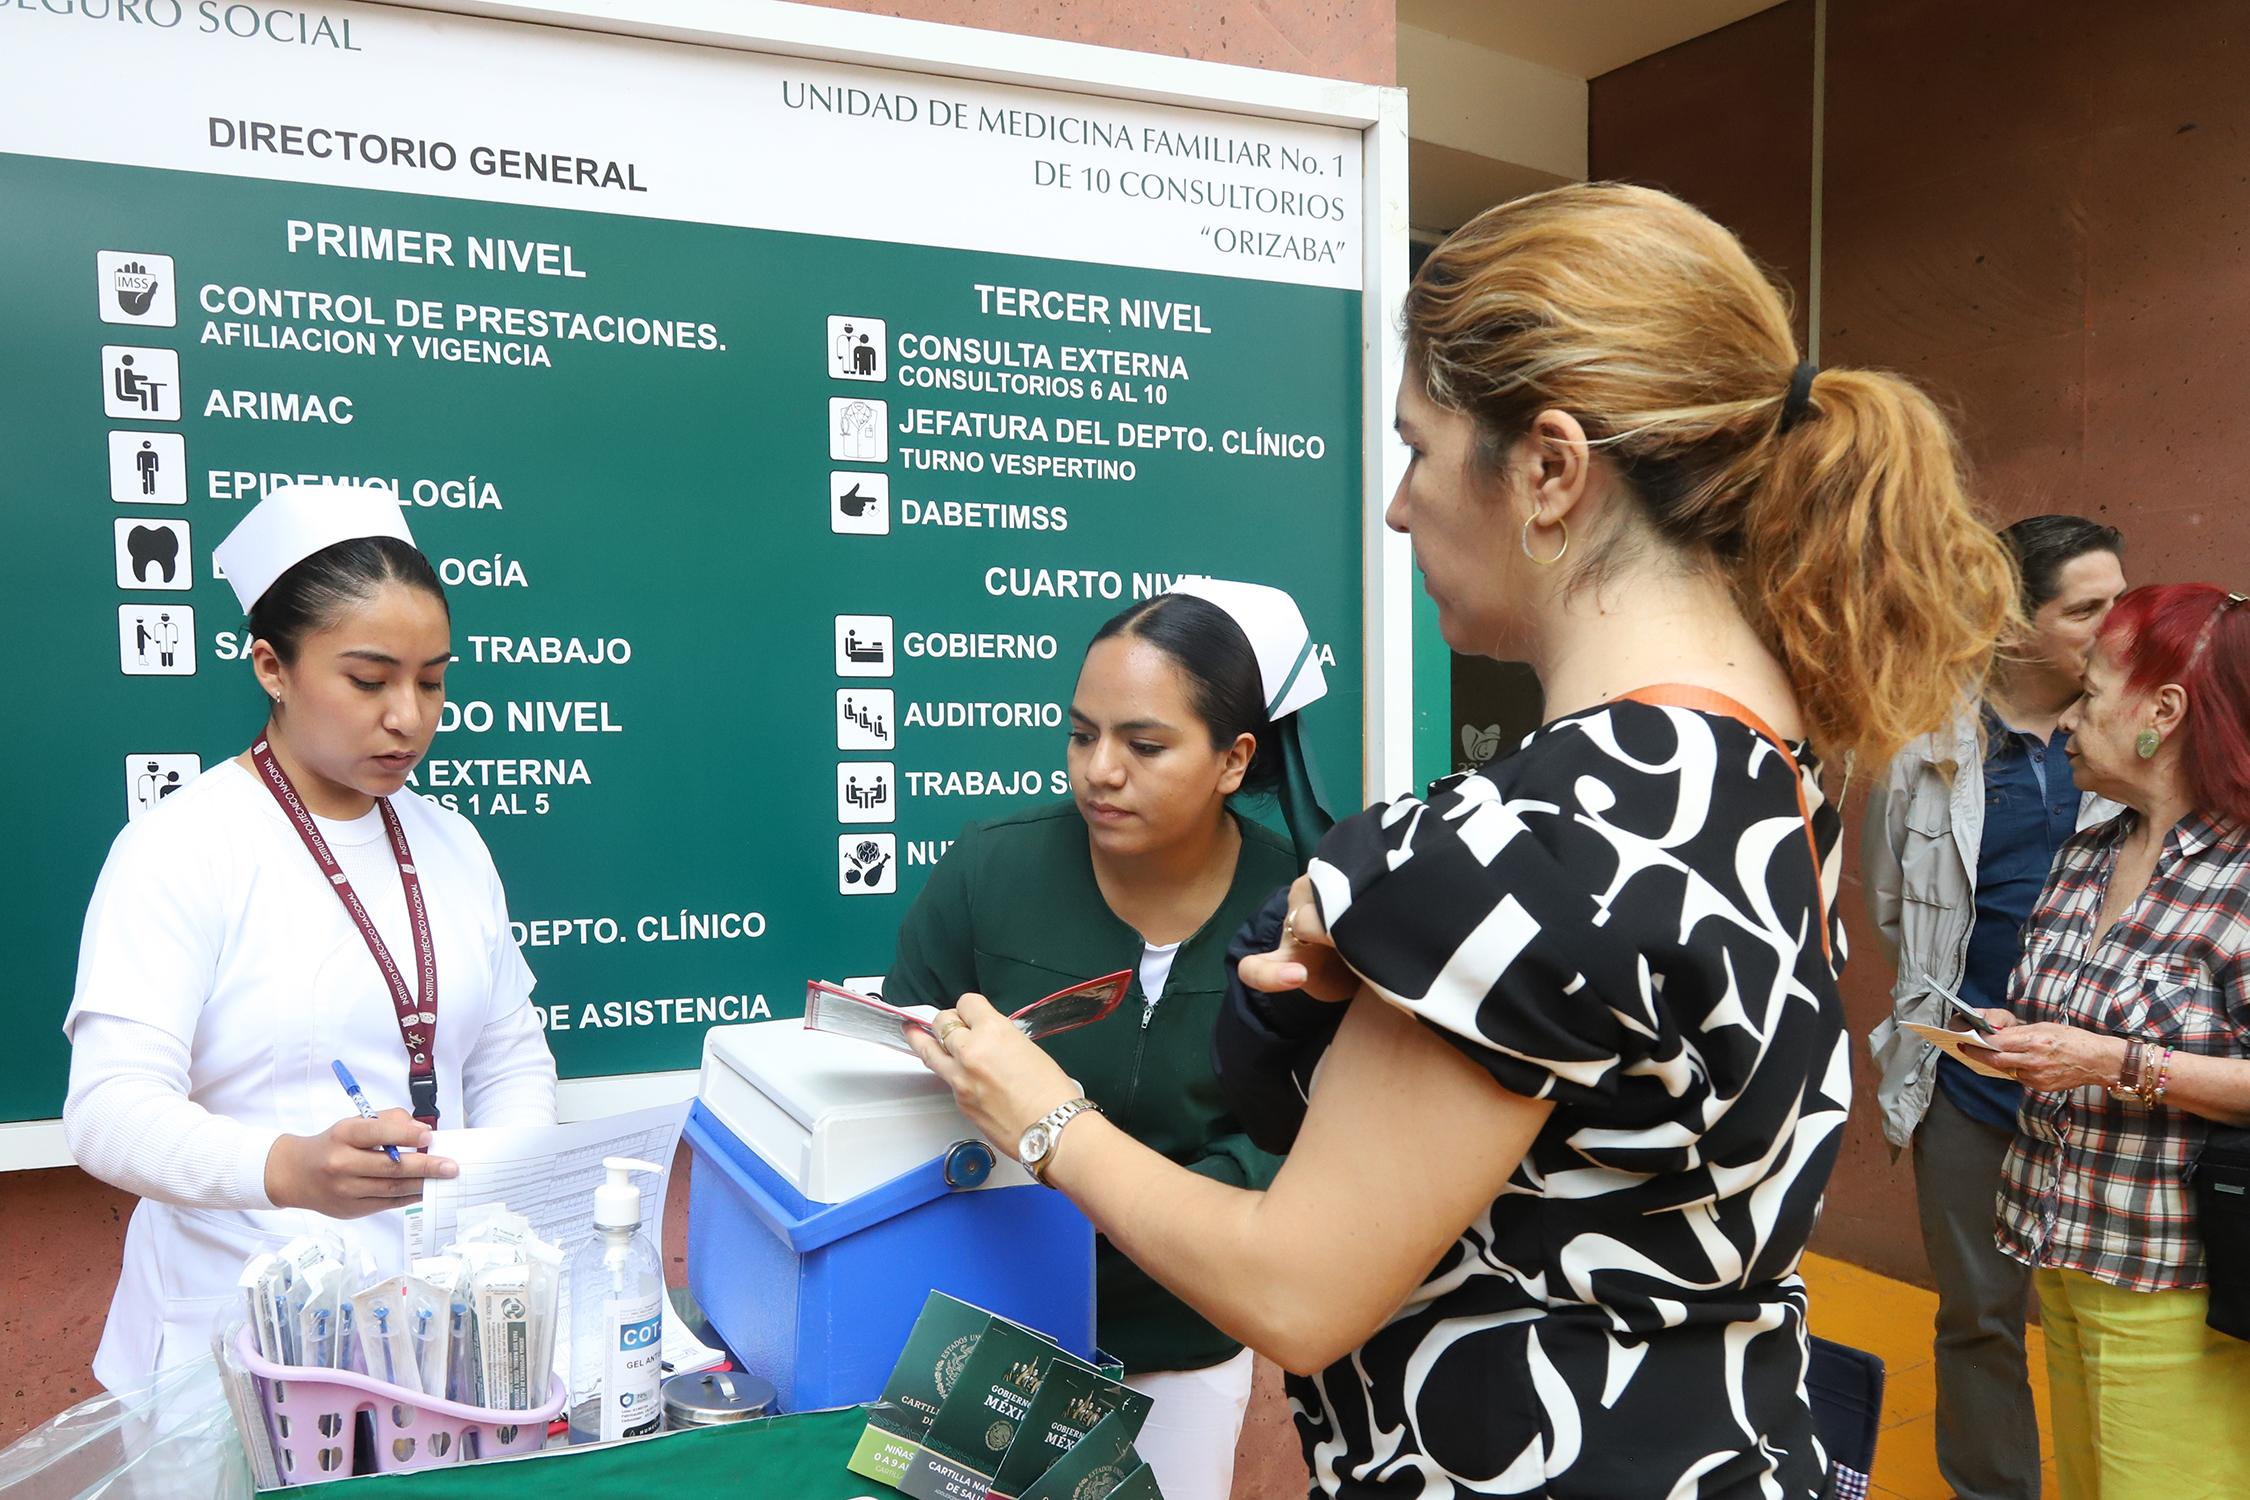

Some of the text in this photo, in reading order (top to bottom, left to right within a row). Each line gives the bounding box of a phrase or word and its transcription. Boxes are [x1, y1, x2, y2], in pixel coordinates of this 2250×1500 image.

[198, 0, 364, 52] SOCIAL
[782, 80, 1342, 178] UNIDAD DE MEDICINA FAMILIAR No. 1
[208, 116, 648, 193] DIRECTORIO GENERAL
[1035, 159, 1344, 221] DE 10 CONSULTORIOS
[287, 219, 587, 278] PRIMER NIVEL
[117, 276, 150, 290] IMSS
[199, 283, 726, 353] CONTROL DE PRESTACIONES.
[973, 283, 1212, 334] TERCER NIVEL
[200, 320, 552, 368] AFILIACION Y VIGENCIA
[898, 333, 1190, 380] CONSULTA EXTERNA
[898, 365, 1168, 405] CONSULTORIOS 6 AL 10
[203, 389, 354, 425] ARIMAC
[898, 408, 1325, 460] JEFATURA DEL DEPTO. CLÍNICO
[899, 447, 1136, 481] TURNO VESPERTINO
[901, 499, 1068, 531] DABETIMSS
[984, 566, 1123, 600] CUARTO
[467, 635, 632, 665] TRABAJO
[903, 632, 1058, 660] GOBIERNO
[507, 701, 623, 732] NIVEL
[903, 702, 1062, 727] AUDITORIO
[264, 757, 290, 793] NACIONAL
[429, 759, 592, 787] EXTERNA
[904, 770, 1042, 796] TRABAJO
[468, 793, 480, 815] 1
[489, 793, 528, 815] AL
[535, 793, 550, 815] 5
[347, 892, 372, 928] NACIONAL
[410, 883, 425, 920] NACIONAL
[637, 909, 766, 942] CLÍNICO
[578, 994, 772, 1029] ASISTENCIA
[623, 1320, 662, 1346] COT
[941, 1335, 968, 1360] ESTADOS
[626, 1359, 644, 1370] GEL
[881, 1455, 890, 1464] A
[890, 1458, 899, 1467] 9
[884, 1443, 915, 1461] NIÑAS
[928, 1461, 971, 1486] CARTILLA
[945, 1482, 961, 1495] DE
